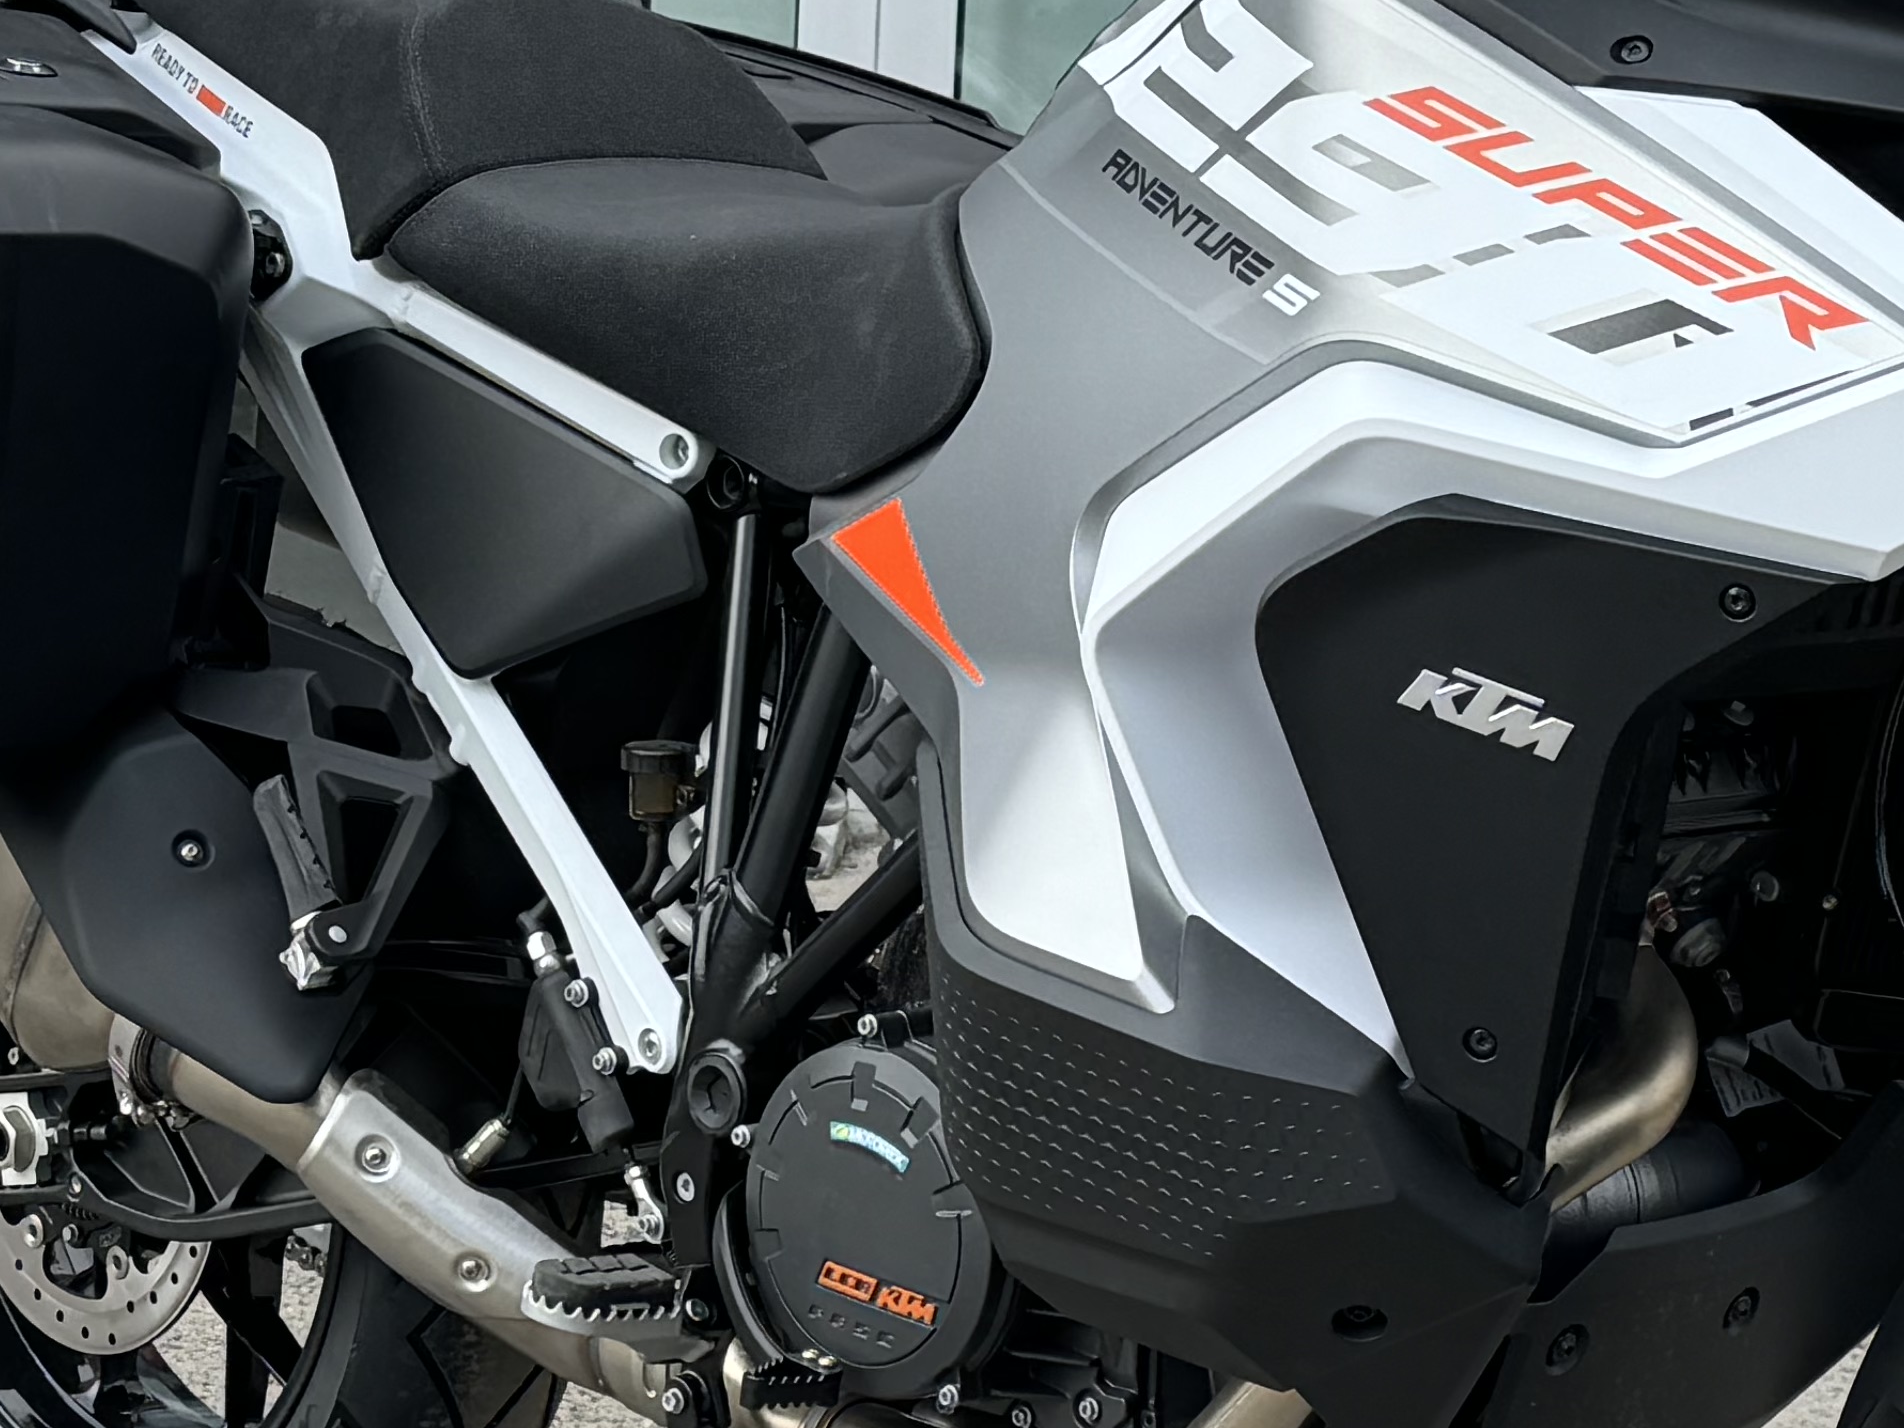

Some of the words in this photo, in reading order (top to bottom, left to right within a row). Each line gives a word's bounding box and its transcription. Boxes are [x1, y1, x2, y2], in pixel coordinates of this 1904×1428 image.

[151, 43, 185, 80] READY
[1101, 148, 1276, 286] ADVENTURE
[1261, 273, 1322, 317] S
[1363, 85, 1871, 351] SUPER
[1396, 667, 1576, 762] KTM
[876, 1285, 938, 1326] KTM
